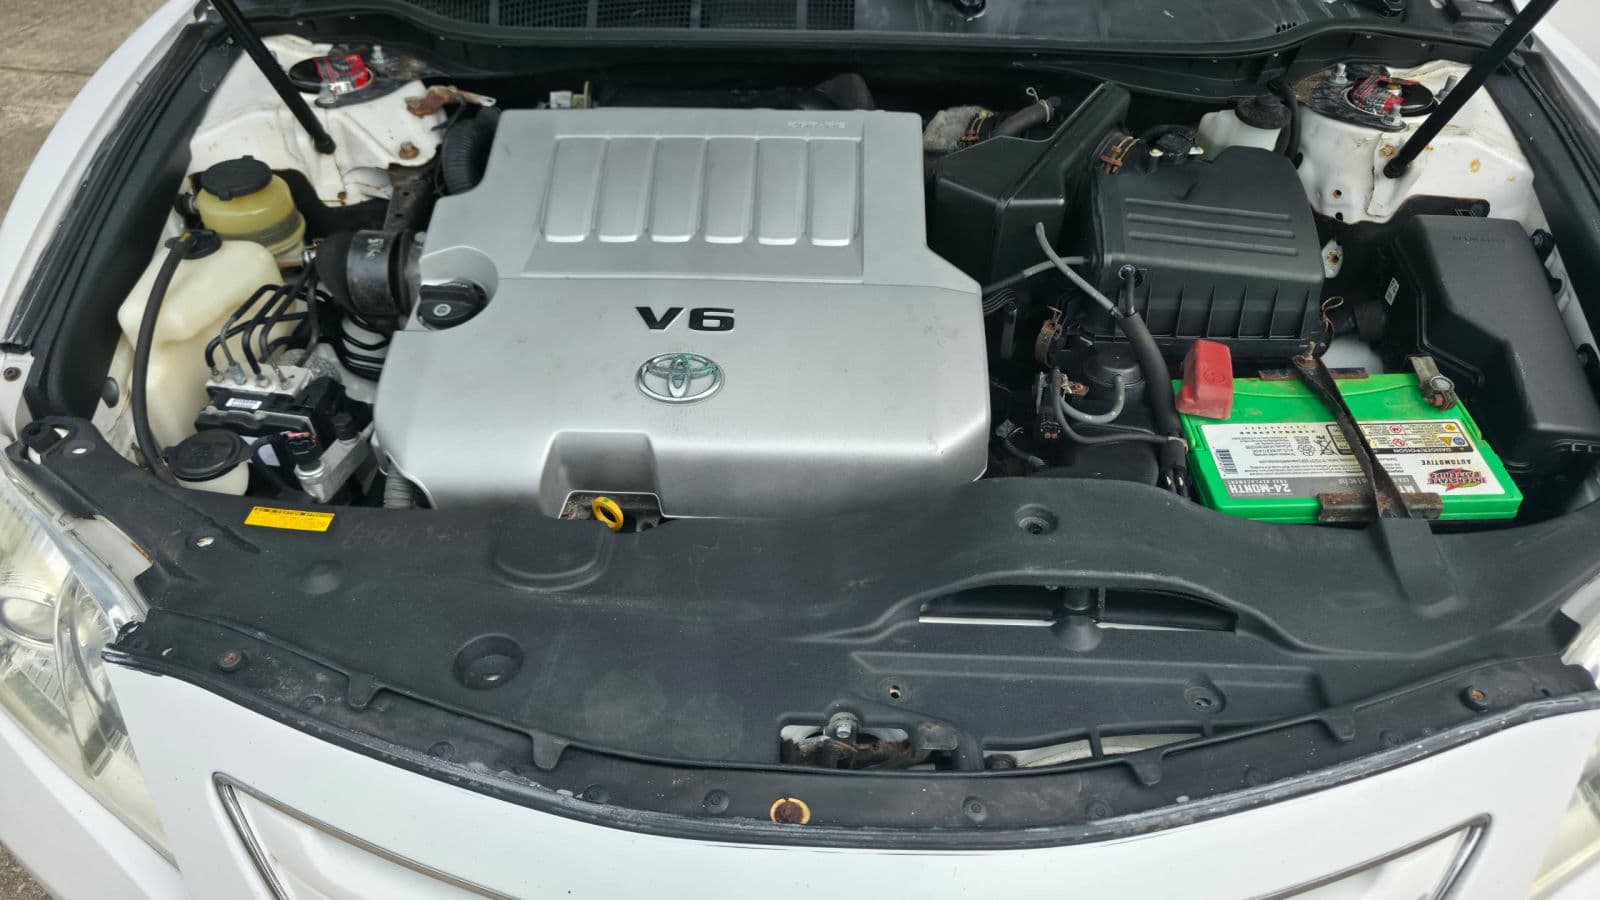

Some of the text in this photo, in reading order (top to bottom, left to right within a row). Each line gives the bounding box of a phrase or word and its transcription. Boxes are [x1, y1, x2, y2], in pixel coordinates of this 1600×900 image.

[635, 306, 735, 332] V6
[1428, 471, 1481, 479] BATTERIES
[1427, 477, 1487, 485] INTERSTATE
[1228, 483, 1292, 494] 24-MONTH
